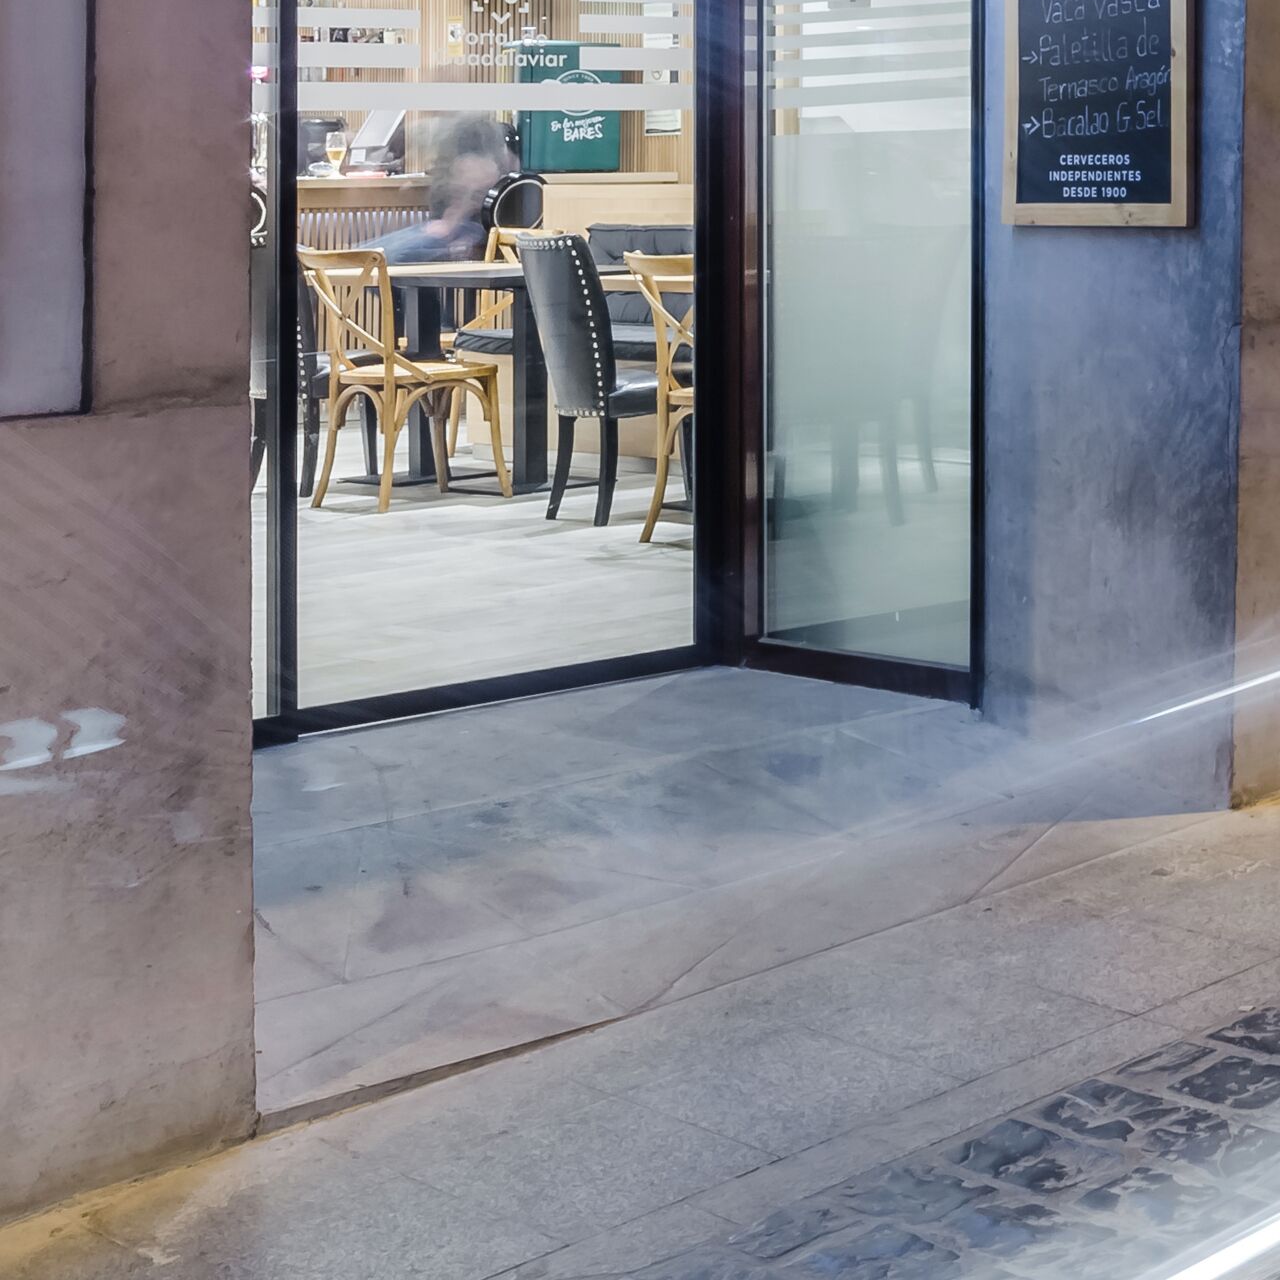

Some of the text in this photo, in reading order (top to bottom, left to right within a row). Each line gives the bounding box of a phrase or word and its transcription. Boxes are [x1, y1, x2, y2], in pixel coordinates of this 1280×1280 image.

[1039, 17, 1159, 65] Paletilla de
[1039, 76, 1119, 102] Ternasco
[1042, 105, 1108, 138] Bacalao
[563, 123, 604, 143] BARES
[1059, 154, 1130, 166] CERVECEROS
[1049, 169, 1141, 182] INDEPENDIENTES
[1063, 186, 1127, 198] DESDE 1900
